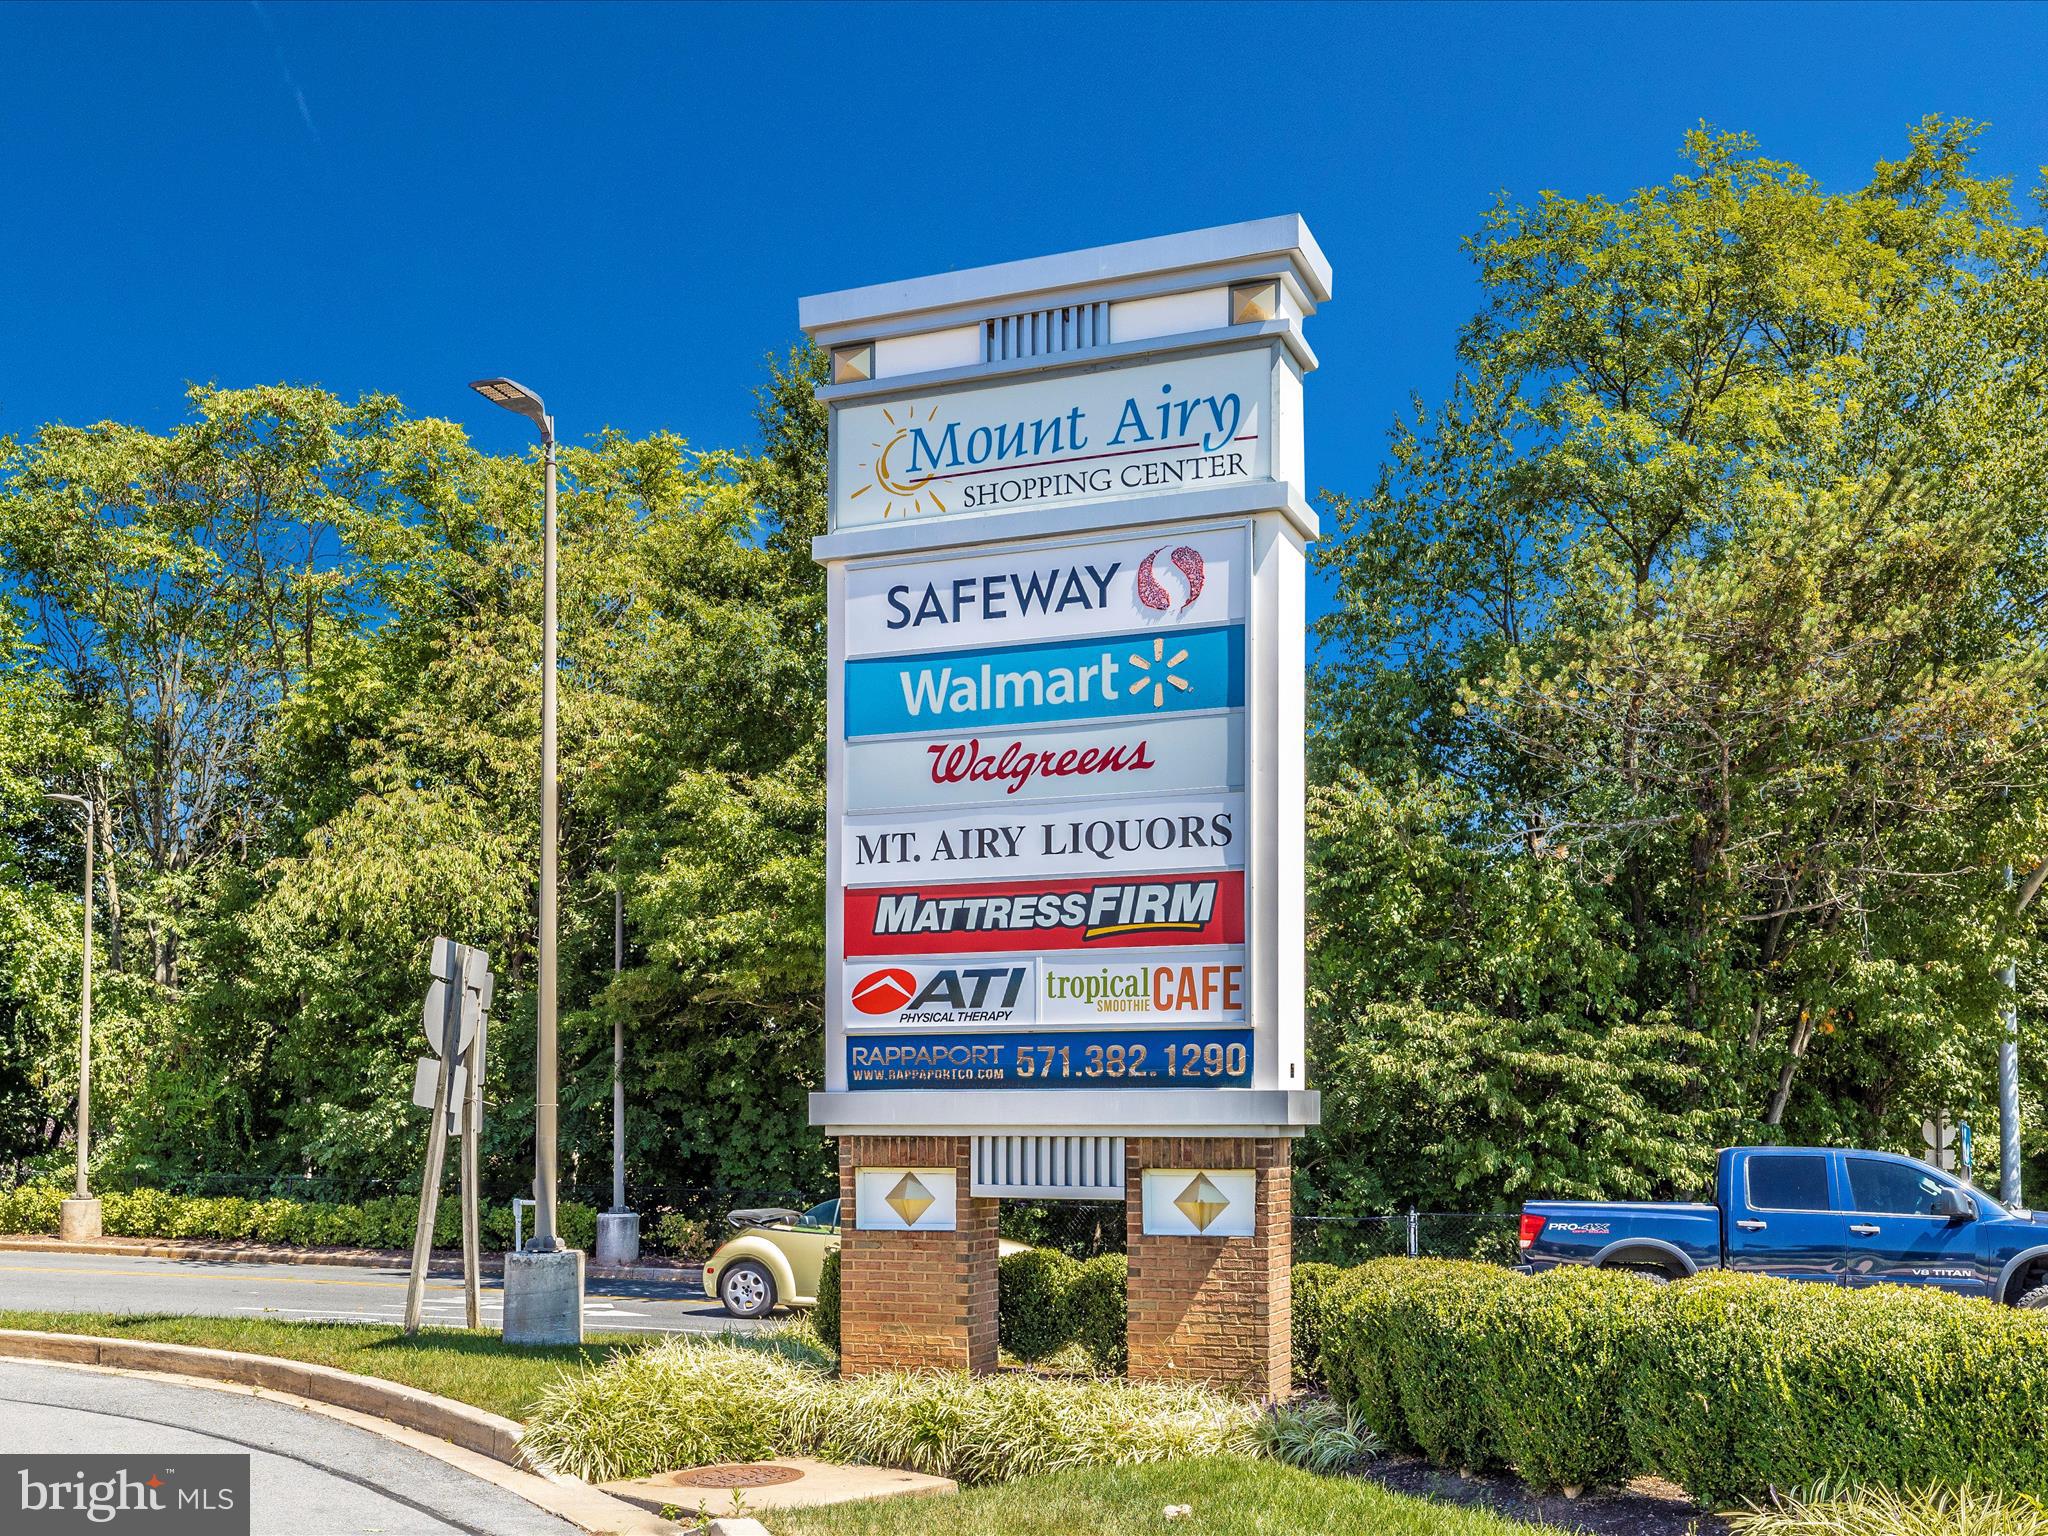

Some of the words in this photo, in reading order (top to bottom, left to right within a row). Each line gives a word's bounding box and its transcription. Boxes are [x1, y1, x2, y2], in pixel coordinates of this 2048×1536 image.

[905, 406, 1088, 474] Mount
[1106, 383, 1242, 454] Airy
[964, 468, 1112, 508] SHOPPING
[1121, 453, 1248, 488] CENTER
[886, 562, 1121, 630] SAFEWAY
[900, 653, 1119, 717] Walmart
[927, 738, 1155, 794] Walgreens
[856, 833, 922, 865] MT.
[931, 826, 1026, 861] AIRY
[1041, 813, 1233, 860] LIQUORS
[906, 967, 1027, 1010] ATI
[1046, 967, 1150, 1004] tropical
[1153, 965, 1243, 1012] CAFE
[1097, 999, 1150, 1012] SMOOTHIE
[899, 1012, 954, 1023] PHYSICAL
[957, 1010, 1012, 1022] THERAPY
[853, 1045, 1004, 1066] RAPPAPORT
[1548, 1223, 1610, 1231] PRO-4X
[1912, 1268, 1930, 1276] V8
[1932, 1269, 1972, 1277] TITAN
